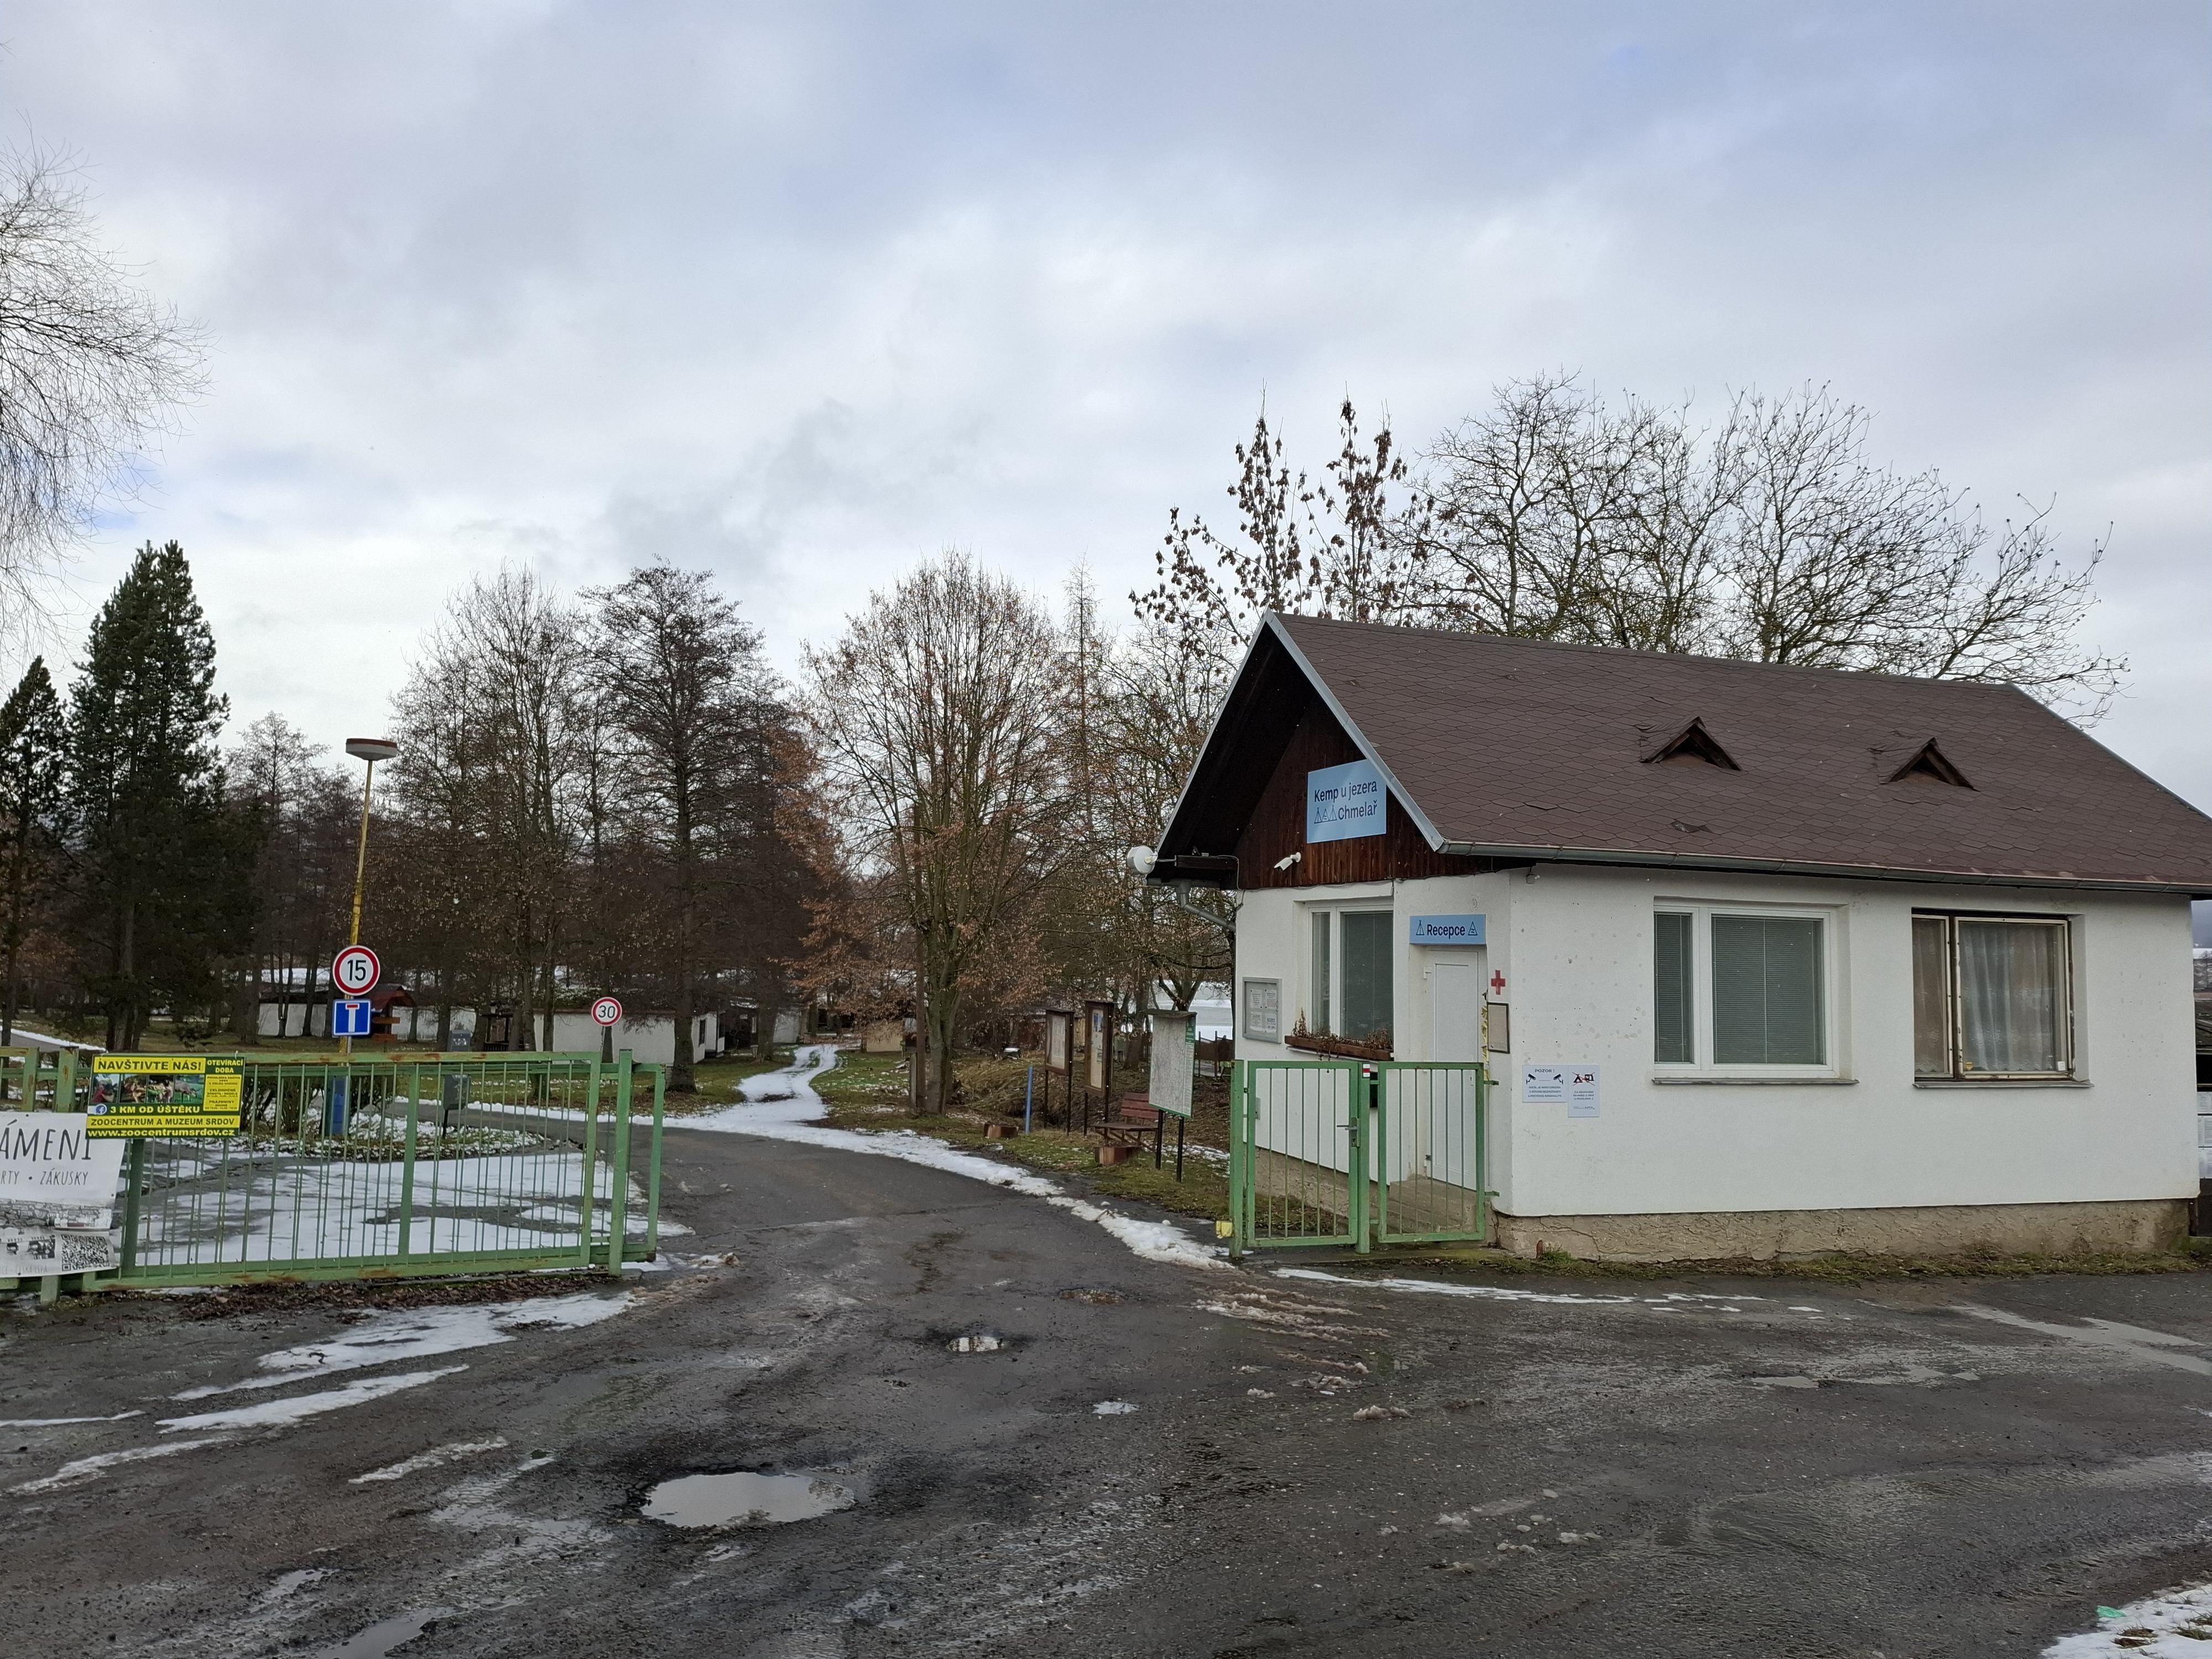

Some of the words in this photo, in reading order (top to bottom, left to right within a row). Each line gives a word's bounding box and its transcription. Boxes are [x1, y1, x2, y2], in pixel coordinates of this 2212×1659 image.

[1314, 789, 1339, 803] Kemp
[1340, 786, 1347, 797] u
[1348, 780, 1377, 801] jezera
[1338, 799, 1377, 820] Chmelař
[1427, 924, 1465, 939] Recepce
[347, 959, 367, 982] 15
[598, 1005, 615, 1018] 30
[98, 1059, 169, 1071] NAVŠTIVTE
[173, 1060, 201, 1071] NÁS!
[87, 1128, 235, 1136] www.zoocentrumsrdov.cz
[40, 1167, 88, 1185] ZÁKUSKY
